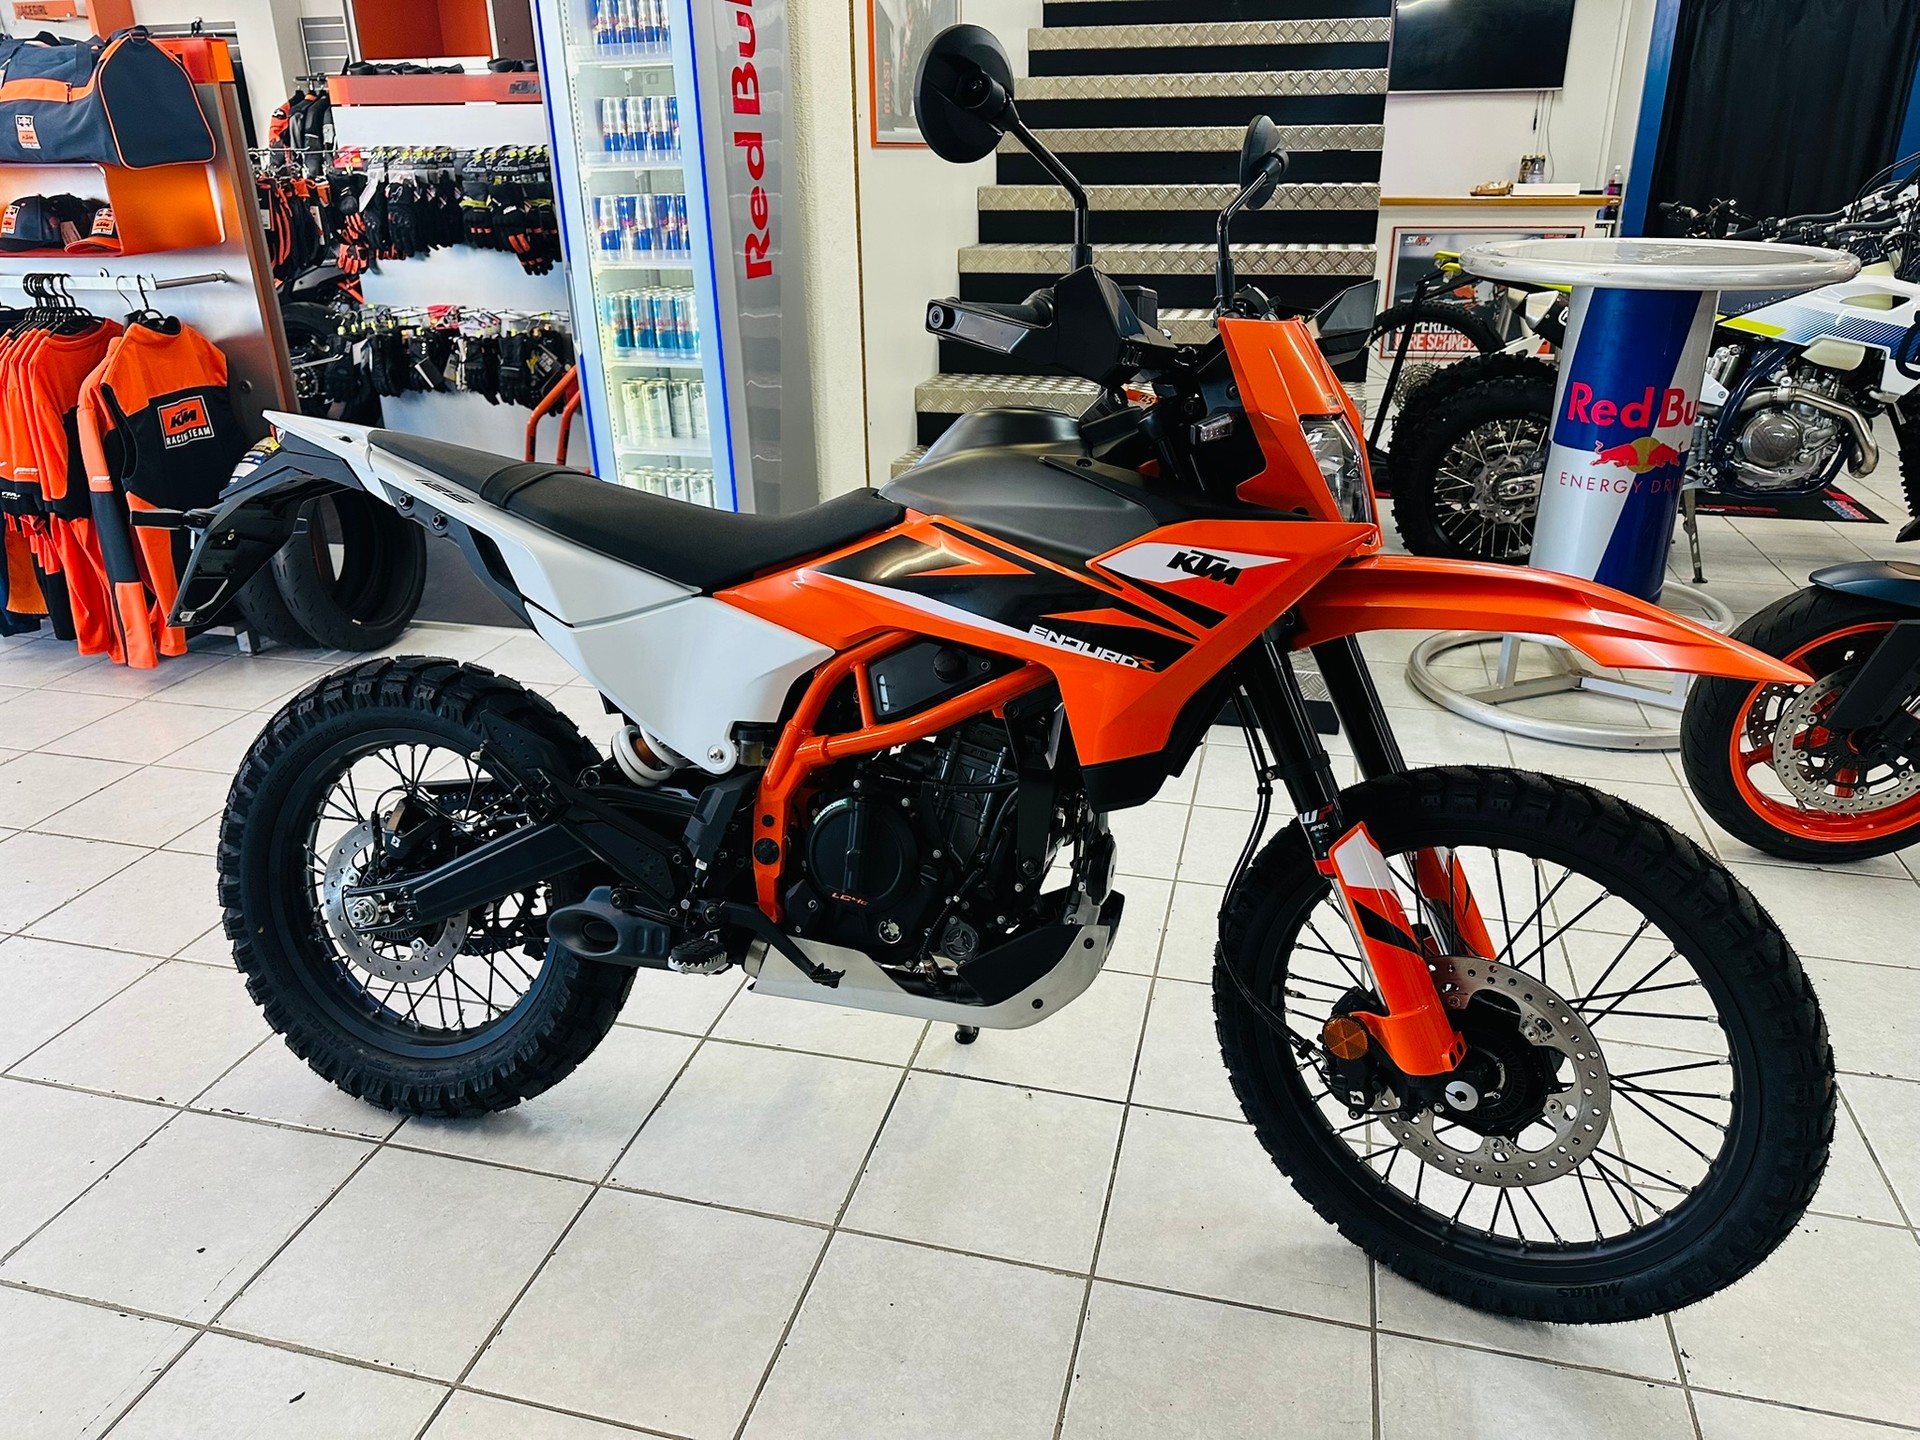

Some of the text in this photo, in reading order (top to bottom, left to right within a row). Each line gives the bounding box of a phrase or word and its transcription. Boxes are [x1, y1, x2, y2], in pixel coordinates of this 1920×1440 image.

[733, 131, 773, 280] Red
[170, 408, 197, 429] KTM
[1567, 381, 1655, 429] Red
[1559, 471, 1643, 495] ENERGY
[1166, 549, 1244, 587] KTM
[1028, 624, 1140, 669] ENDURO
